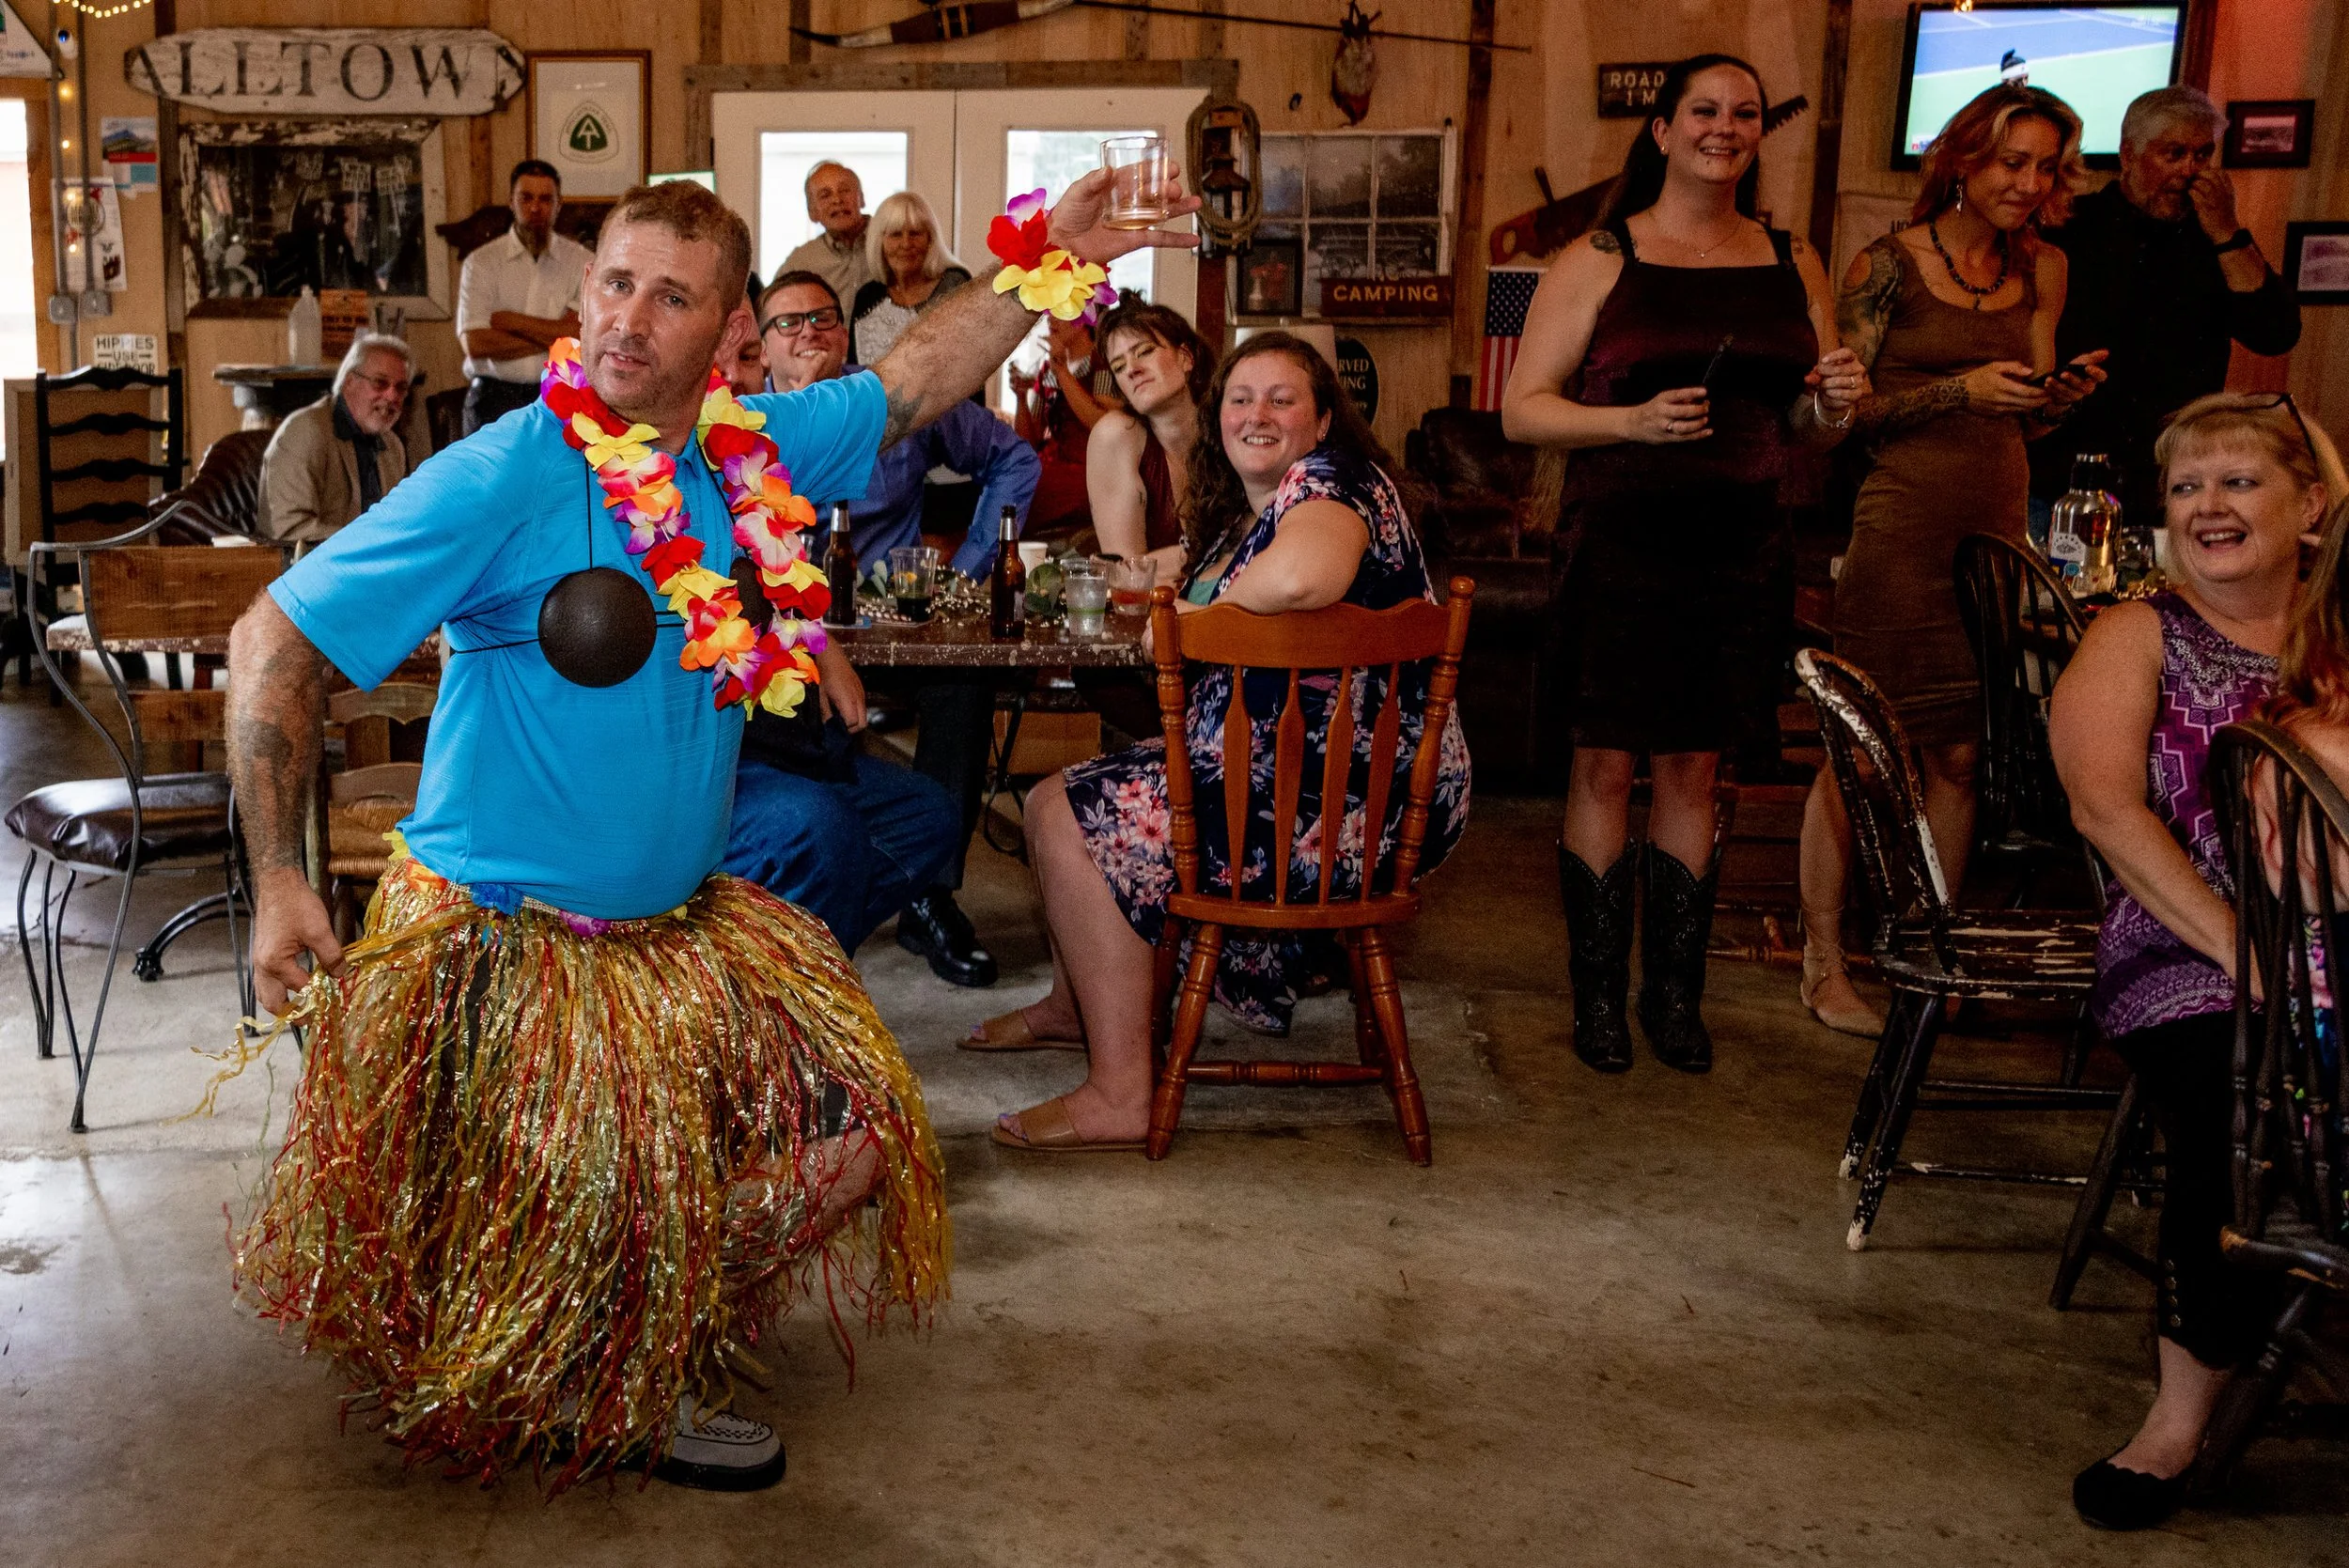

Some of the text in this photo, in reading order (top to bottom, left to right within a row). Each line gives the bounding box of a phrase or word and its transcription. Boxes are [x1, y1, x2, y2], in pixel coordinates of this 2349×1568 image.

[1610, 70, 1665, 88] ROAD
[1333, 285, 1439, 302] CAMPING
[97, 336, 154, 350] HIPPIES
